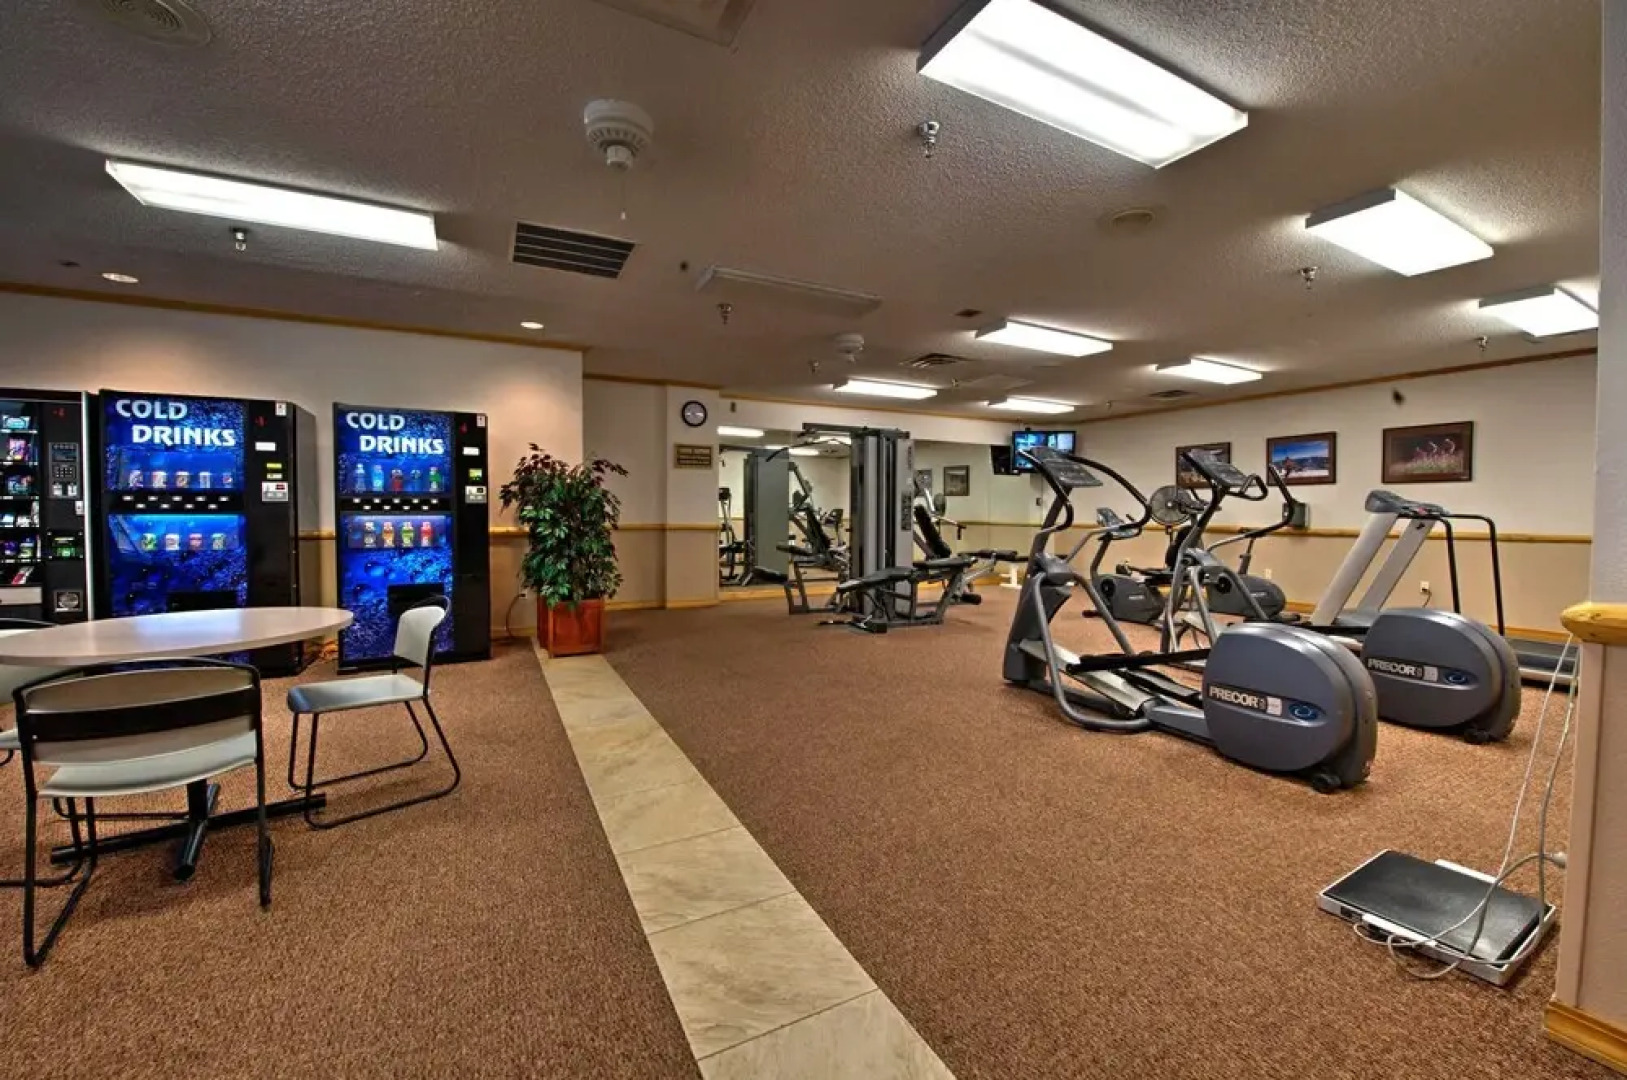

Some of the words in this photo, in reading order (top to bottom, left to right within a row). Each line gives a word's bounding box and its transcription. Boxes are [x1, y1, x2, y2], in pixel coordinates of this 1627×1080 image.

[115, 399, 188, 420] COLD
[346, 412, 405, 431] COLD
[132, 424, 236, 447] DRINKS
[360, 435, 445, 454] DRINKS
[1368, 658, 1415, 676] PRECOR
[1209, 685, 1259, 708] PRECOR
